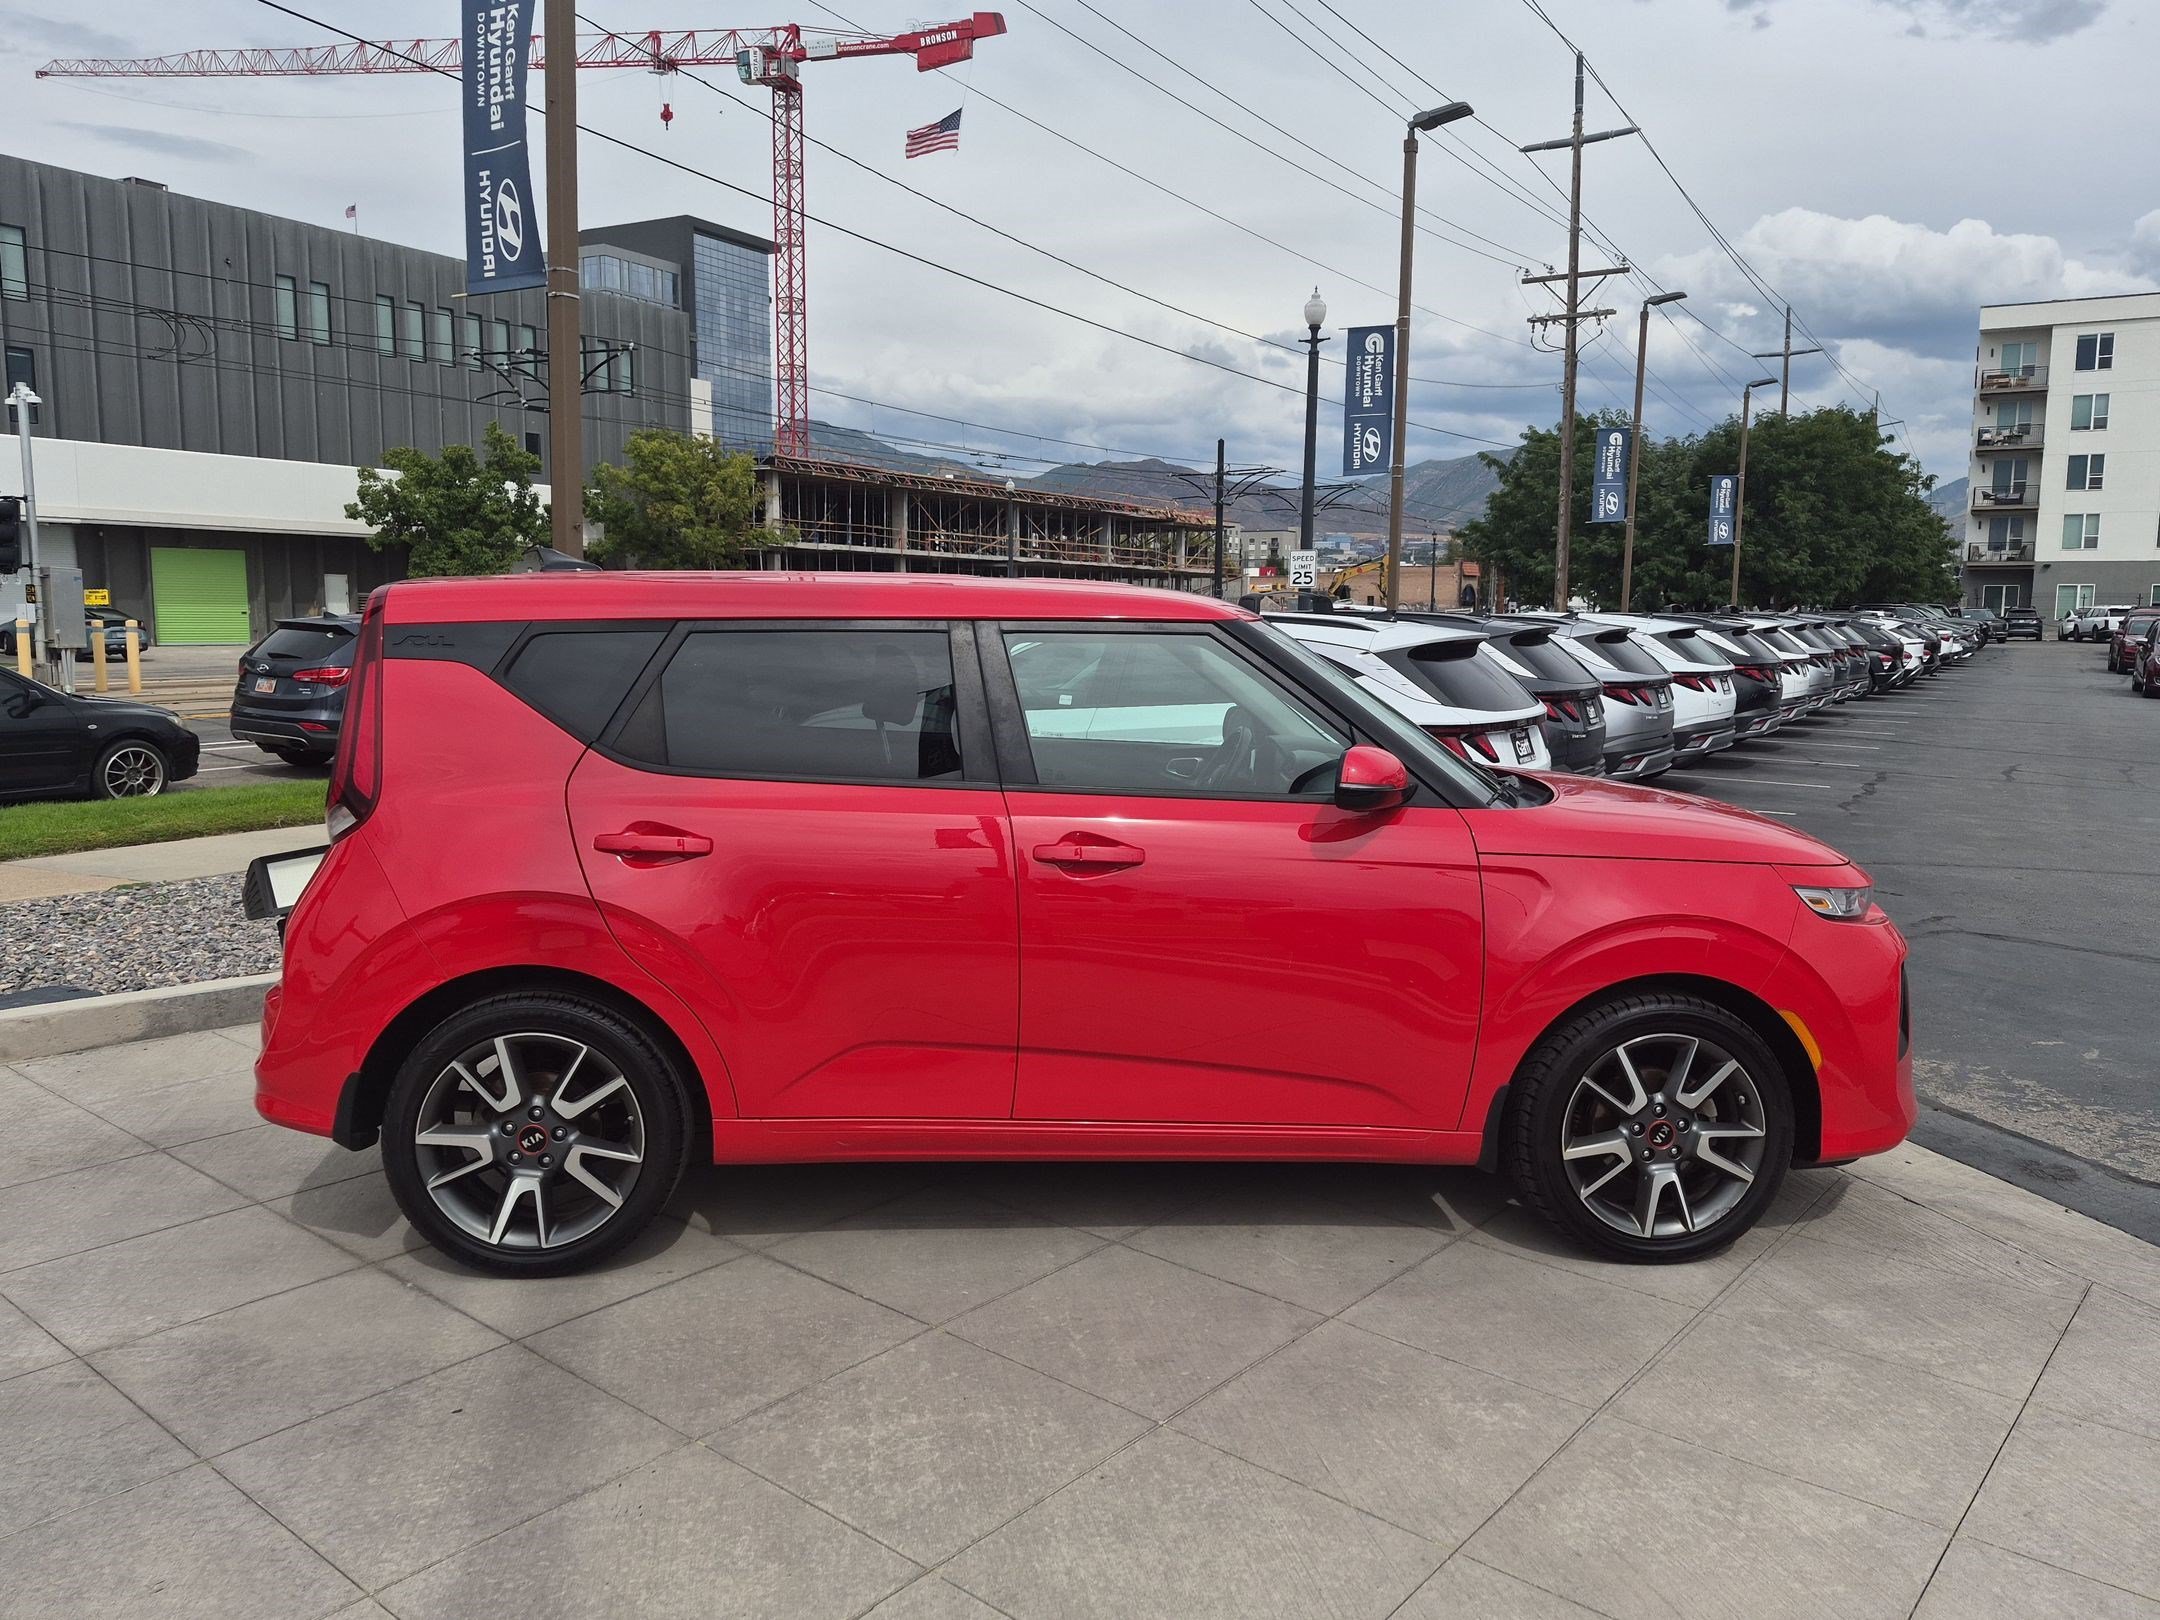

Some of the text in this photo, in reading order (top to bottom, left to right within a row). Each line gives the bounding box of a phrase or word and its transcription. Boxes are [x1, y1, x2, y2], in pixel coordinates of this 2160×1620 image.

[477, 12, 486, 107] DOWNTOWN
[505, 3, 519, 100] Ken Garff
[837, 43, 890, 52] bronsoncrane.com
[920, 30, 957, 47] BRONSON
[488, 7, 505, 131] Hyundai
[479, 170, 496, 278] HYUNDAI
[1362, 355, 1375, 408] Hyundai
[1374, 354, 1384, 396] Ken Garff
[1353, 423, 1361, 469] HYUNDAI
[1606, 446, 1615, 480] Hyundai
[1292, 571, 1313, 585] 25
[521, 1132, 544, 1149] KIA
[1653, 1125, 1670, 1144] KIA
